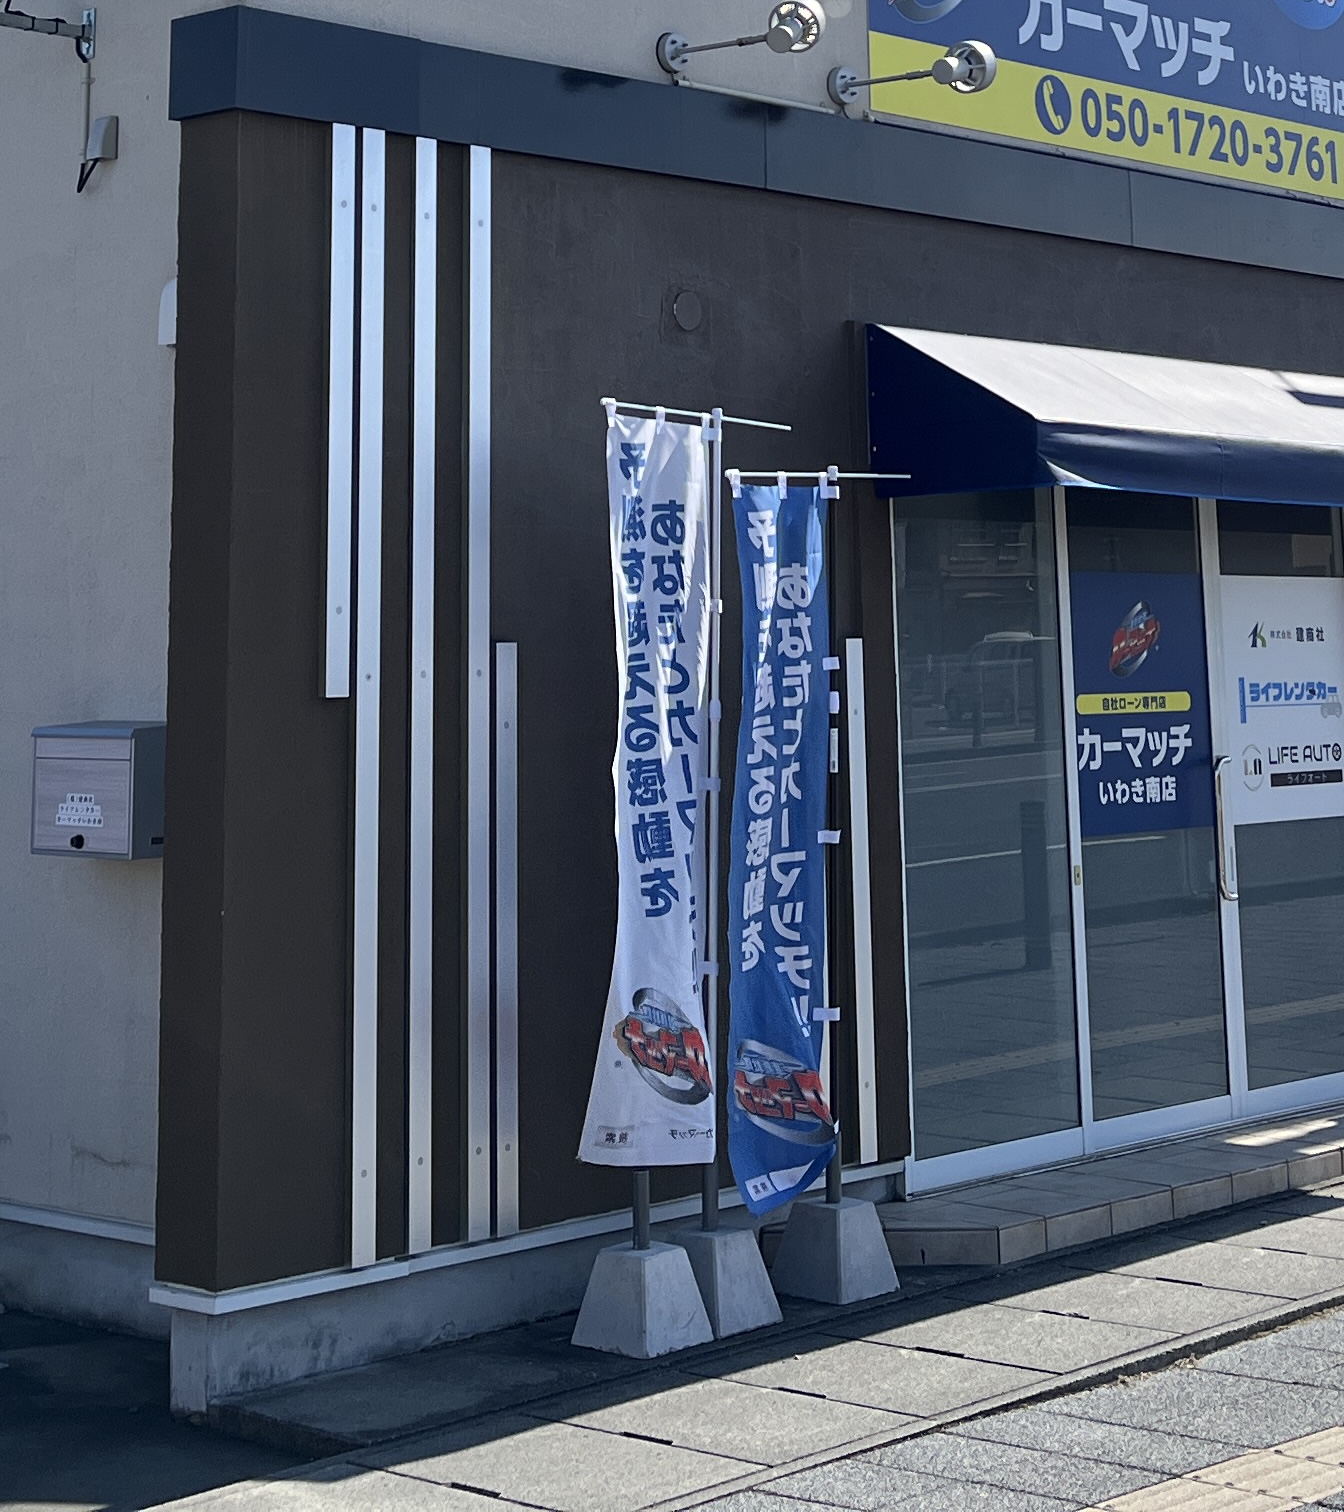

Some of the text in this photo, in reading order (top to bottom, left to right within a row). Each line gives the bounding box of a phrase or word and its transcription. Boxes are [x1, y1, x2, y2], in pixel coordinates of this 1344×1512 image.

[1080, 88, 1338, 184] 050-1720-3761
[1249, 681, 1338, 701] ライフレンタカー
[1102, 697, 1166, 711] 自社ローン専門店
[1077, 724, 1193, 771] カーマッチ
[1268, 746, 1299, 765] LIFE
[1099, 775, 1176, 805] いわき南店
